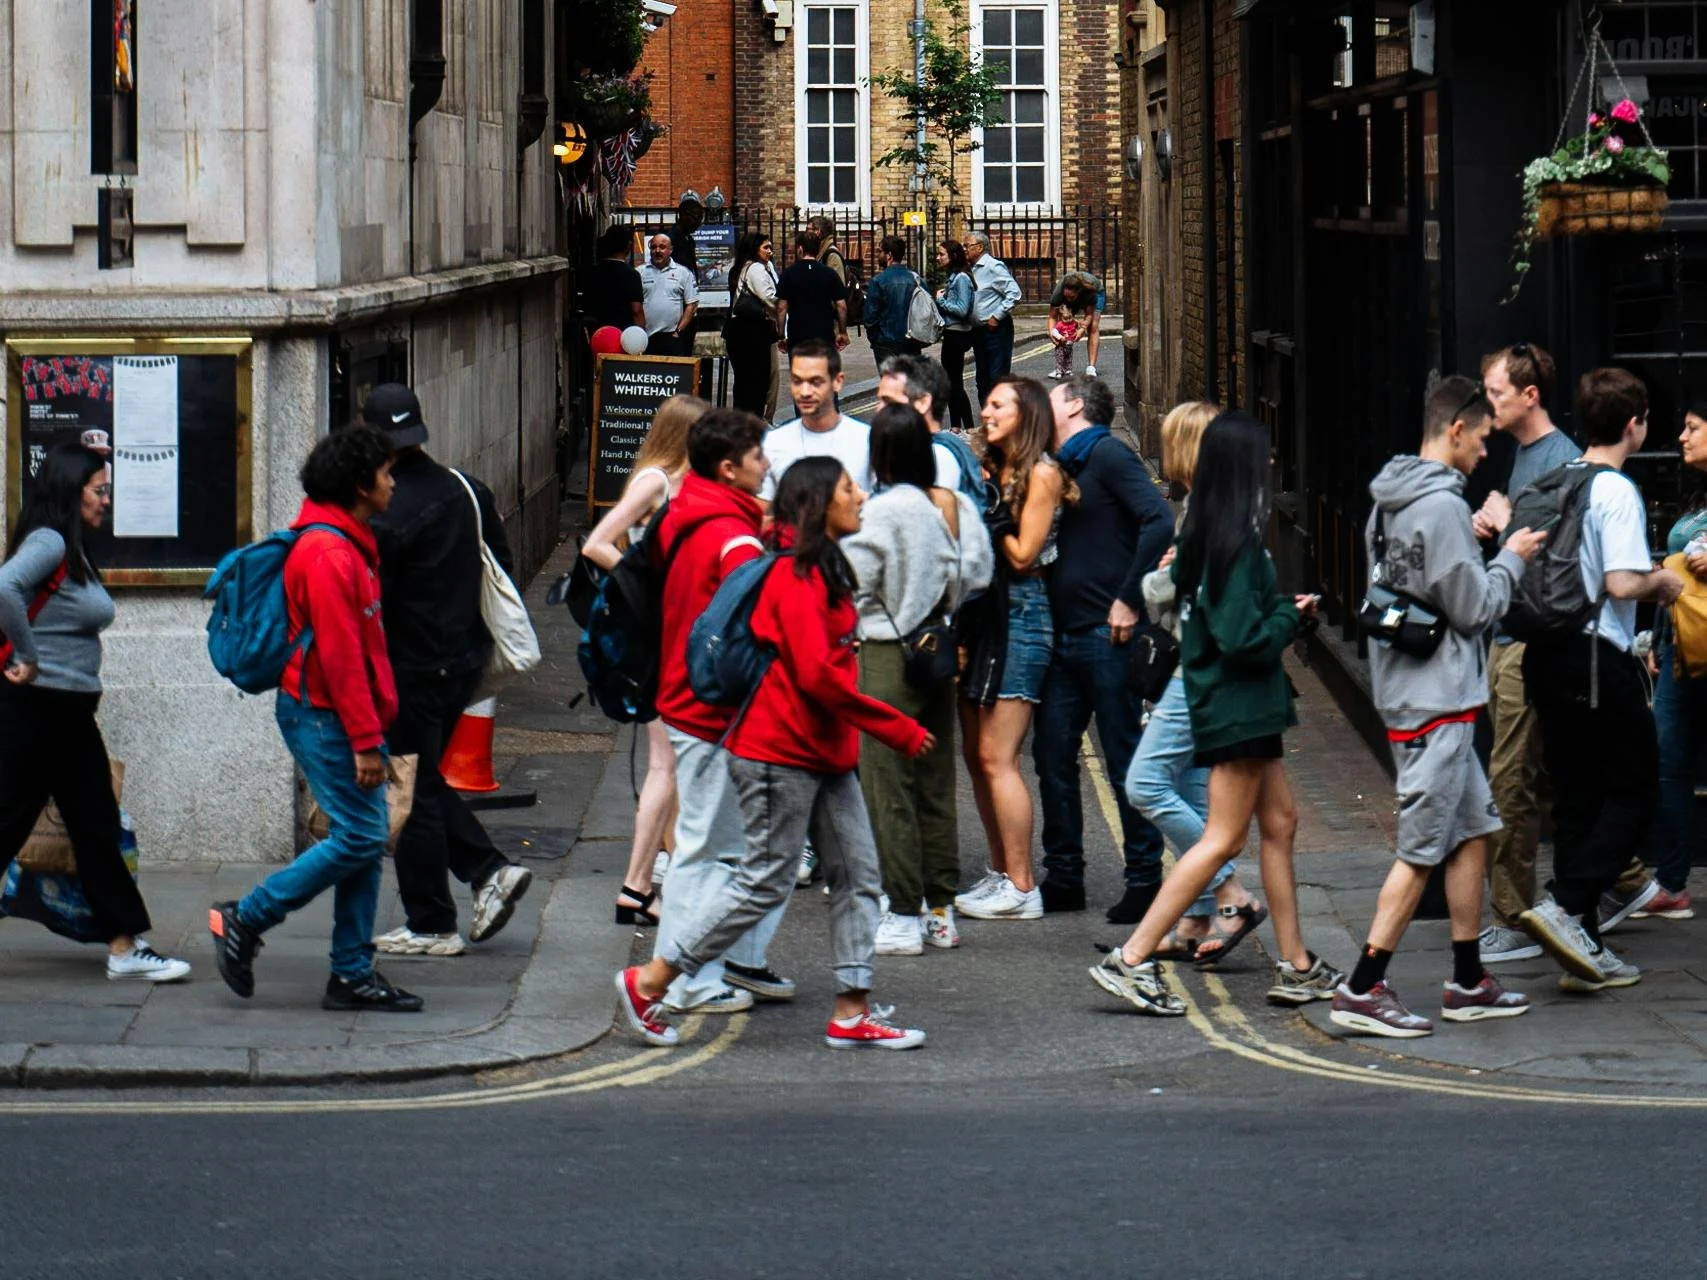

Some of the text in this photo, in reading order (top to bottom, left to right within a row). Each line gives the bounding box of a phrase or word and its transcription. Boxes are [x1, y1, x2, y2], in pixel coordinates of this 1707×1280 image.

[614, 372, 680, 385] WALKERS OF
[605, 405, 642, 414] Welcome
[600, 419, 644, 430] Traditional
[610, 435, 637, 444] Classic
[600, 449, 622, 458] Hand
[613, 465, 632, 474] floor
